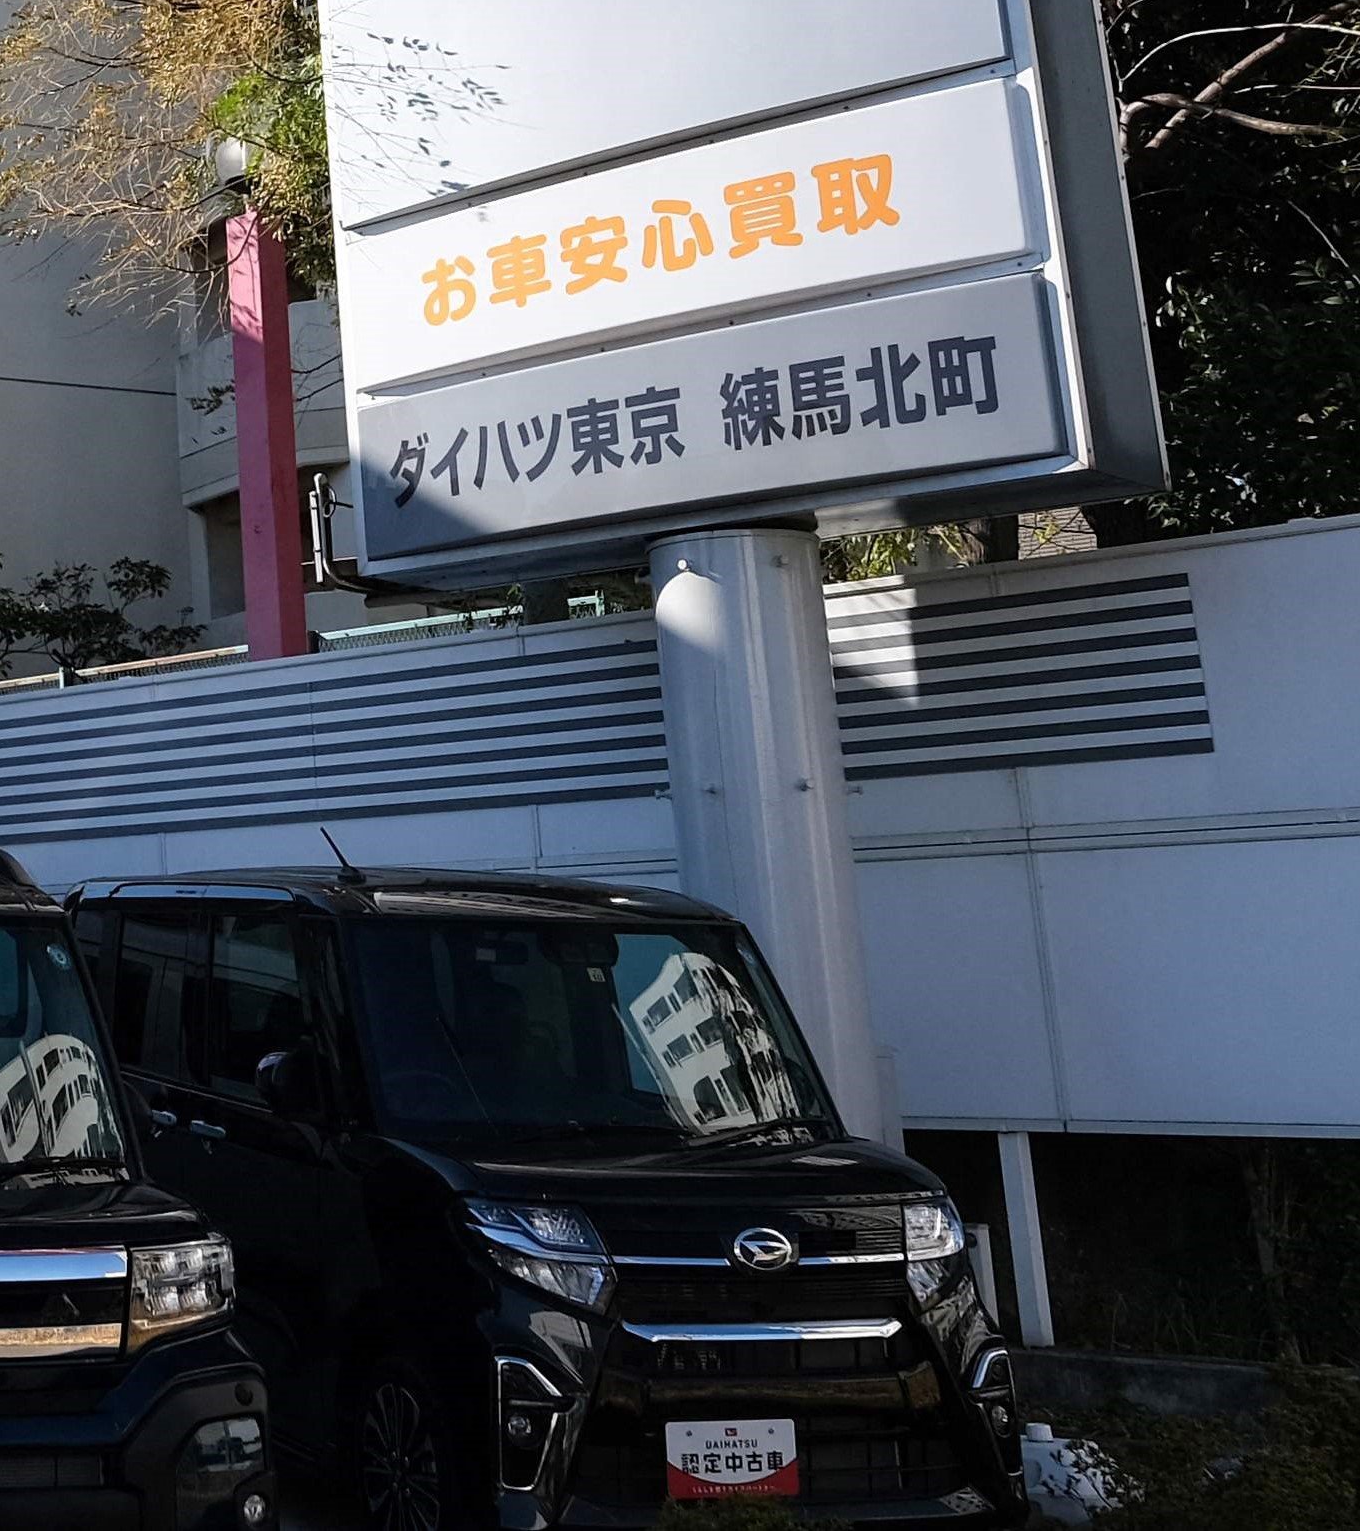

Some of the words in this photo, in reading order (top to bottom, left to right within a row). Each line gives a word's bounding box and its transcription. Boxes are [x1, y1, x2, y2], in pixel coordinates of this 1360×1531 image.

[422, 154, 901, 326] お車安心買取
[389, 386, 686, 509] ダイハツ東京
[720, 336, 998, 451] 練馬北町
[681, 1450, 783, 1474] 認定中古車
[705, 1439, 758, 1450] DAIHATSU
